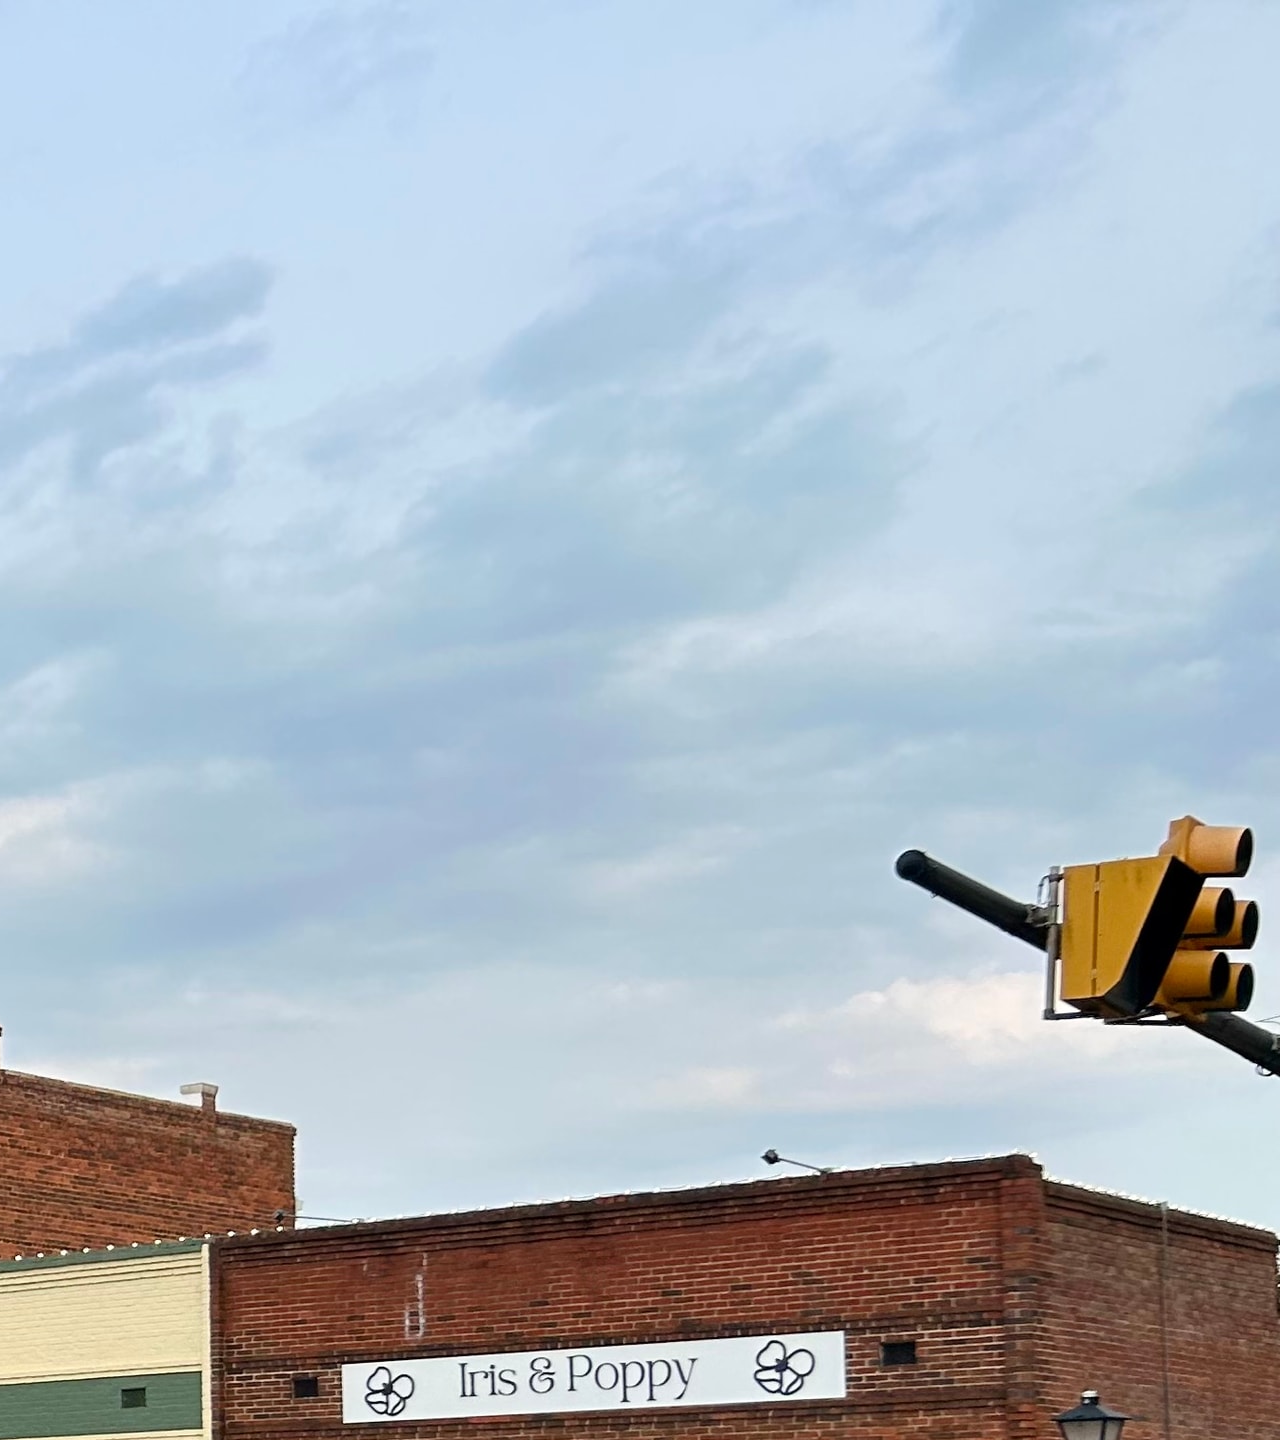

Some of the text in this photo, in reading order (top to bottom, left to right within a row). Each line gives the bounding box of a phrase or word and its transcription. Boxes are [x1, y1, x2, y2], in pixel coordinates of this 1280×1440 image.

[458, 1354, 698, 1403] Iris & Poppy
